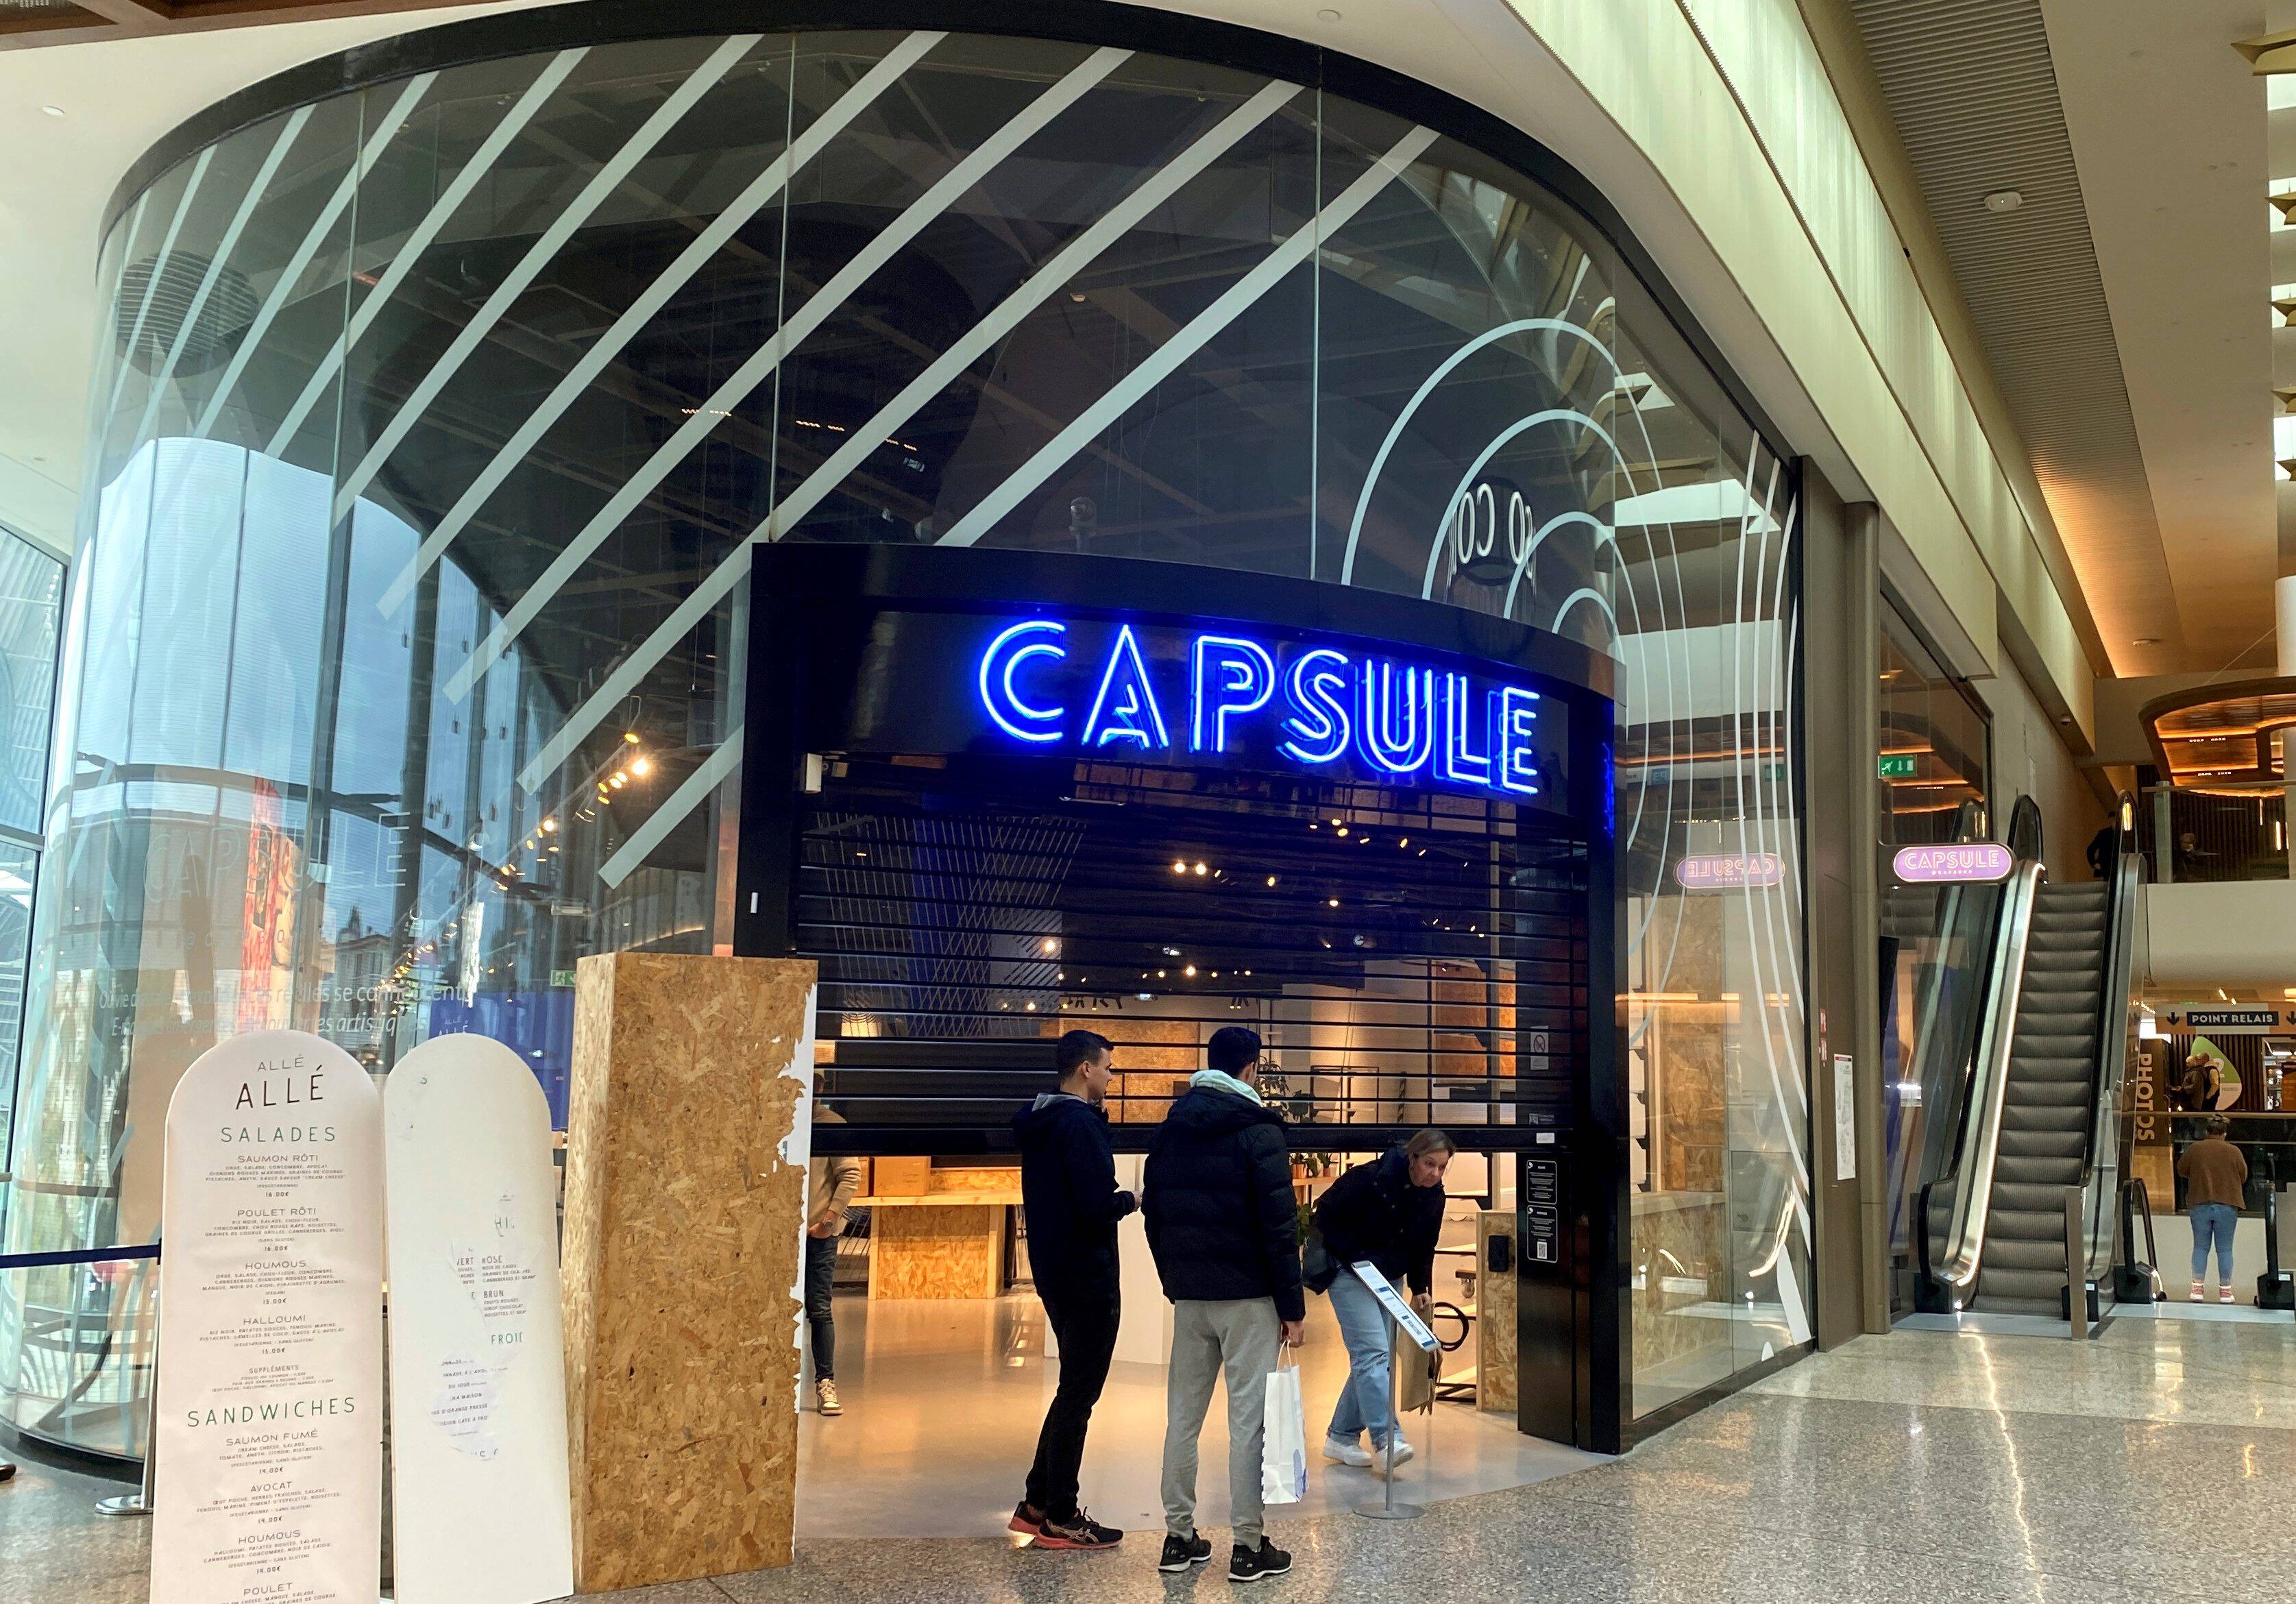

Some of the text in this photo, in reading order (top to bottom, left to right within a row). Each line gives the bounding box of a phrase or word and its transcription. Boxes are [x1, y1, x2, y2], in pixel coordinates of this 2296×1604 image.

[980, 621, 1540, 794] CAPSULE
[1905, 850, 1999, 870] CAPSULE
[334, 988, 352, 1001] se
[2192, 1014, 2273, 1023] POINT RELAIS
[258, 1054, 304, 1071] ALLÉ
[236, 1065, 323, 1110] ALLÉ
[221, 1127, 335, 1143] SALADES
[293, 1153, 318, 1162] RÔTI
[291, 1206, 316, 1215] RÔTI
[245, 1260, 306, 1269] HOUMOUS
[484, 1290, 504, 1298] BRUN
[243, 1315, 306, 1325] HALLOUMI
[249, 1365, 299, 1374] SUPPLÉMENTS
[187, 1398, 354, 1427] SANDWICHES
[226, 1428, 318, 1446] SAUMON FUMÉ
[251, 1481, 292, 1492] AVOCAT
[239, 1530, 301, 1544] HOUMOUS
[243, 1582, 292, 1596] POULET
